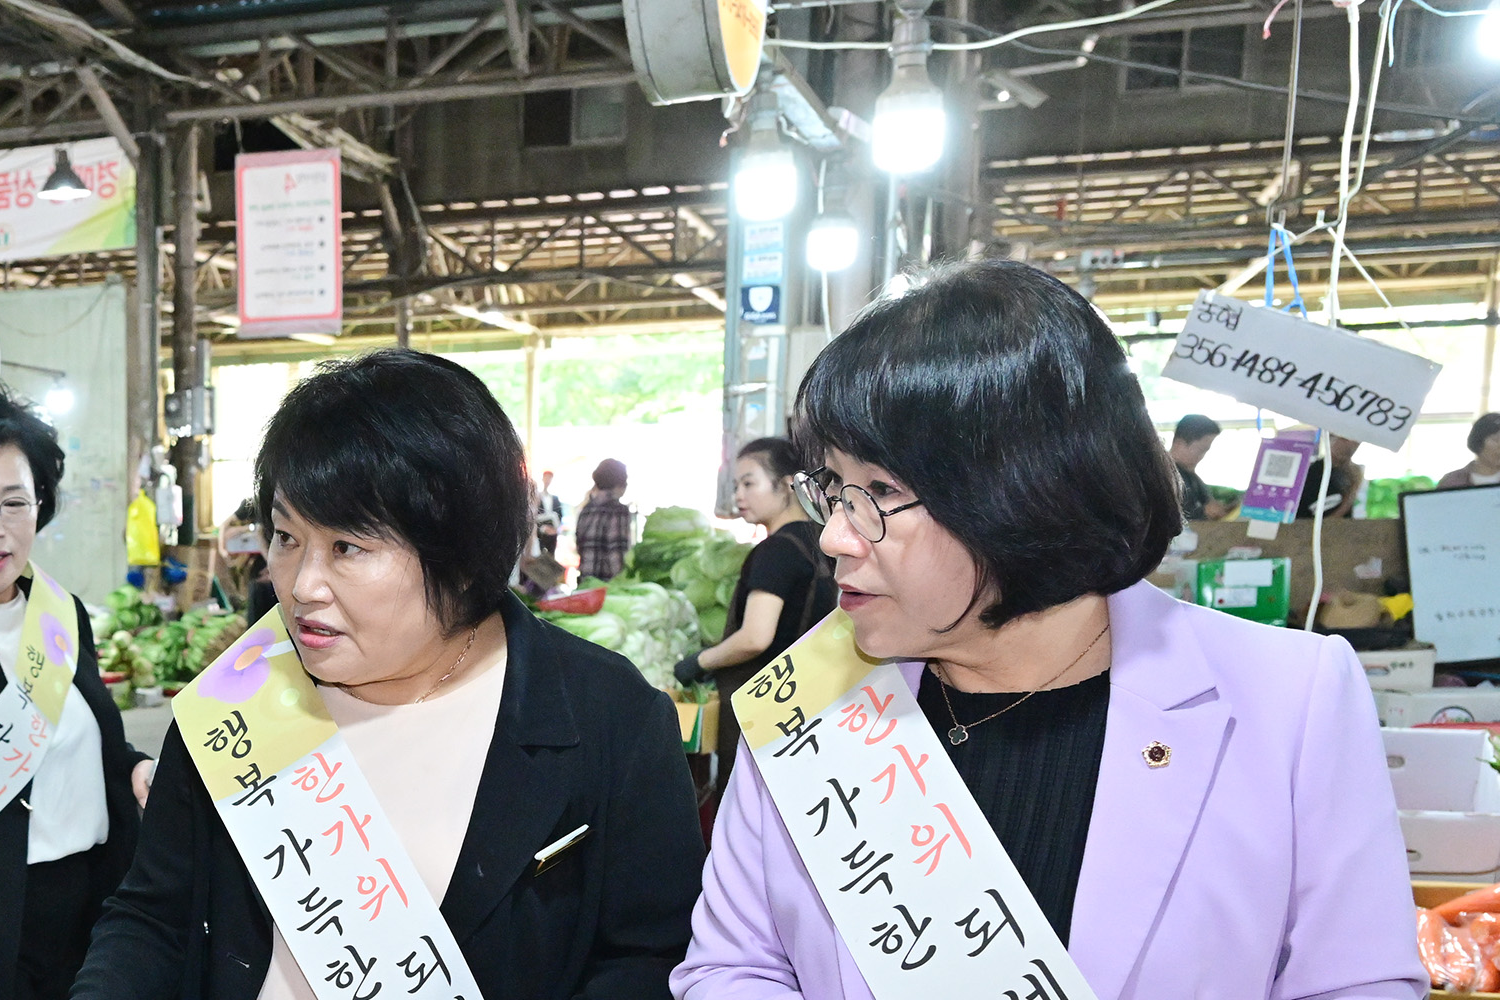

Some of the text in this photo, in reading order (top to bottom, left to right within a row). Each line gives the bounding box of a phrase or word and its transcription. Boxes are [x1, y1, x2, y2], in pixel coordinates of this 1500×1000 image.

[17, 645, 45, 710] 행복
[202, 709, 278, 808] 행복
[290, 751, 411, 922] 한가위
[746, 653, 937, 971] 행복 가득한
[837, 684, 974, 878] 한가위
